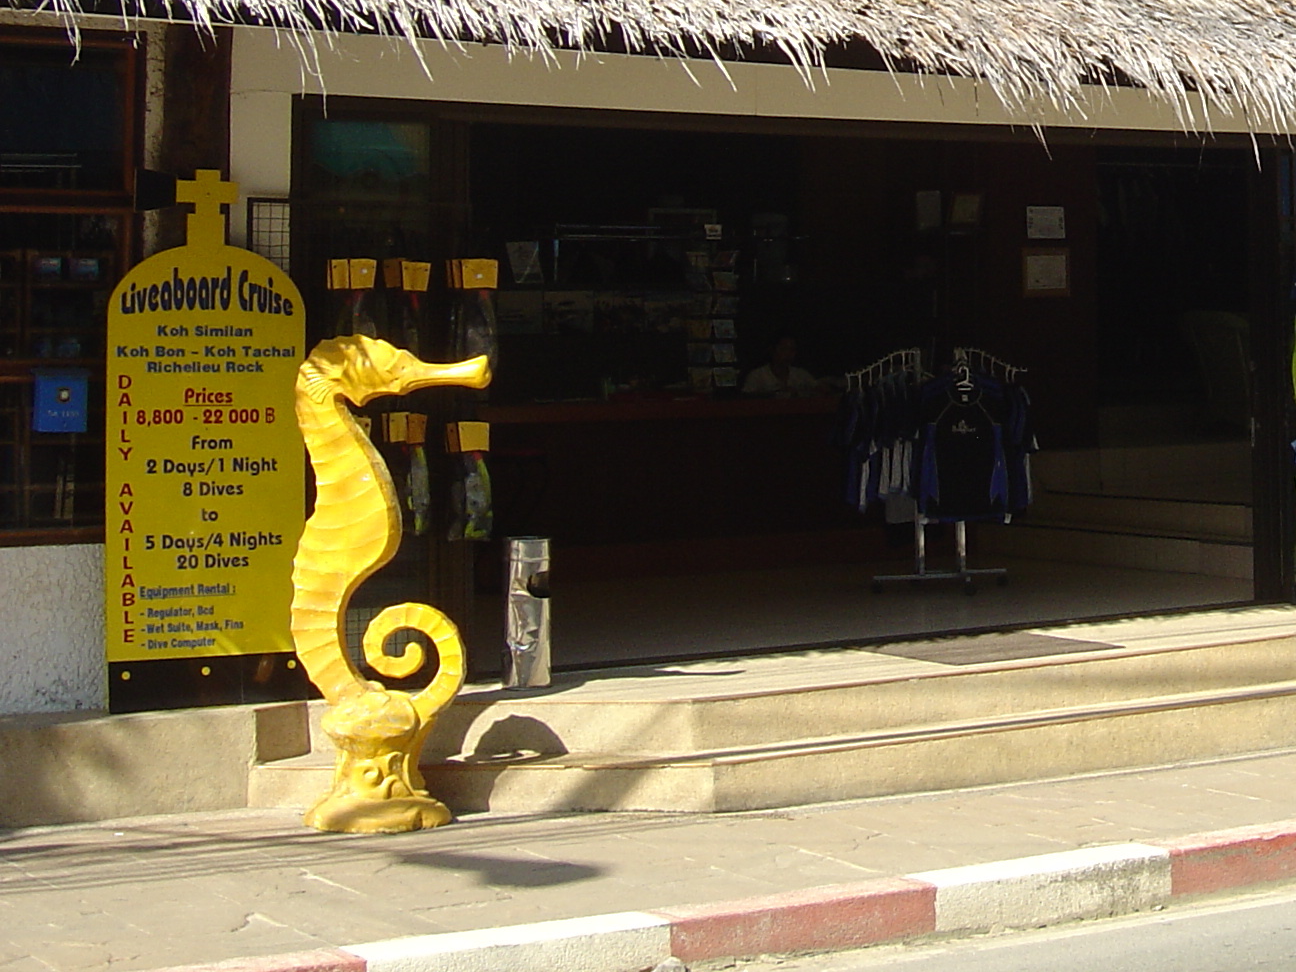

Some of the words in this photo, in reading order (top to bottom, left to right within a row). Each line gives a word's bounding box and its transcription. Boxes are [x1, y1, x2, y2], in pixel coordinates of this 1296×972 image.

[120, 265, 232, 315] Liveaboard
[238, 268, 294, 317] Cruise
[157, 325, 189, 337] Koh
[194, 325, 254, 337] Similan
[116, 345, 149, 358] Koh
[155, 346, 186, 358] Bon
[204, 345, 236, 358] Koh
[242, 345, 296, 358] Tachai
[147, 361, 221, 374] Richelieu
[225, 361, 265, 374] Rock
[184, 387, 234, 406] Prices
[117, 375, 133, 461] DAILY
[136, 409, 185, 427] 8,800
[203, 408, 224, 425] 22
[229, 408, 260, 424] 000
[192, 435, 233, 450] From
[146, 459, 158, 475] 2
[232, 458, 279, 476] Night
[182, 482, 193, 497] 8
[199, 481, 244, 497] Dives
[201, 508, 219, 522] to
[145, 535, 156, 550] 5
[229, 532, 283, 551] Nights
[176, 554, 199, 570] 20
[204, 554, 250, 569] Dives
[139, 585, 195, 599] Equipment
[197, 605, 214, 616] Bcd
[146, 624, 164, 634] Wet
[147, 639, 168, 650] Dive
[170, 636, 217, 650] Computer
